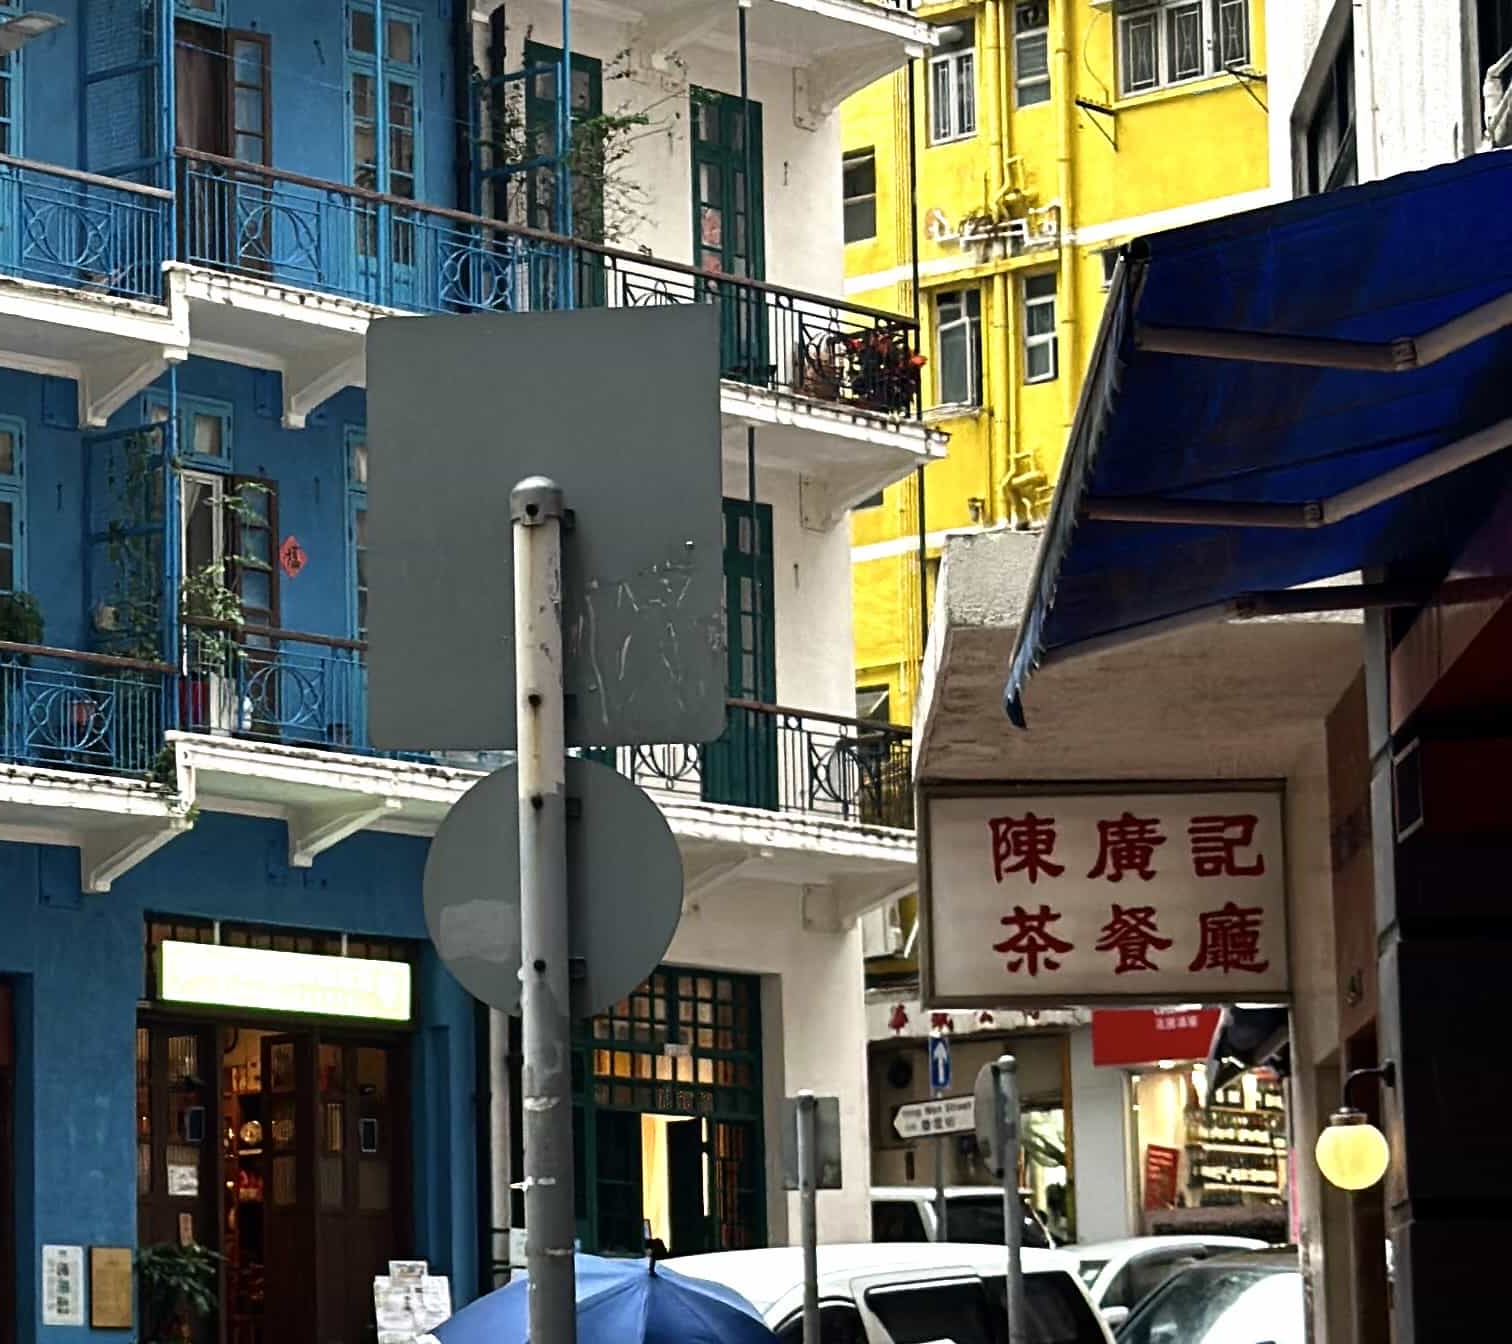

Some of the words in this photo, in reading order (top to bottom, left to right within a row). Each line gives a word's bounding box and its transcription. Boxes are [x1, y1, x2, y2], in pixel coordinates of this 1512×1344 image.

[988, 812, 1265, 885] 陳廣記
[992, 902, 1270, 977] 茶餐廳
